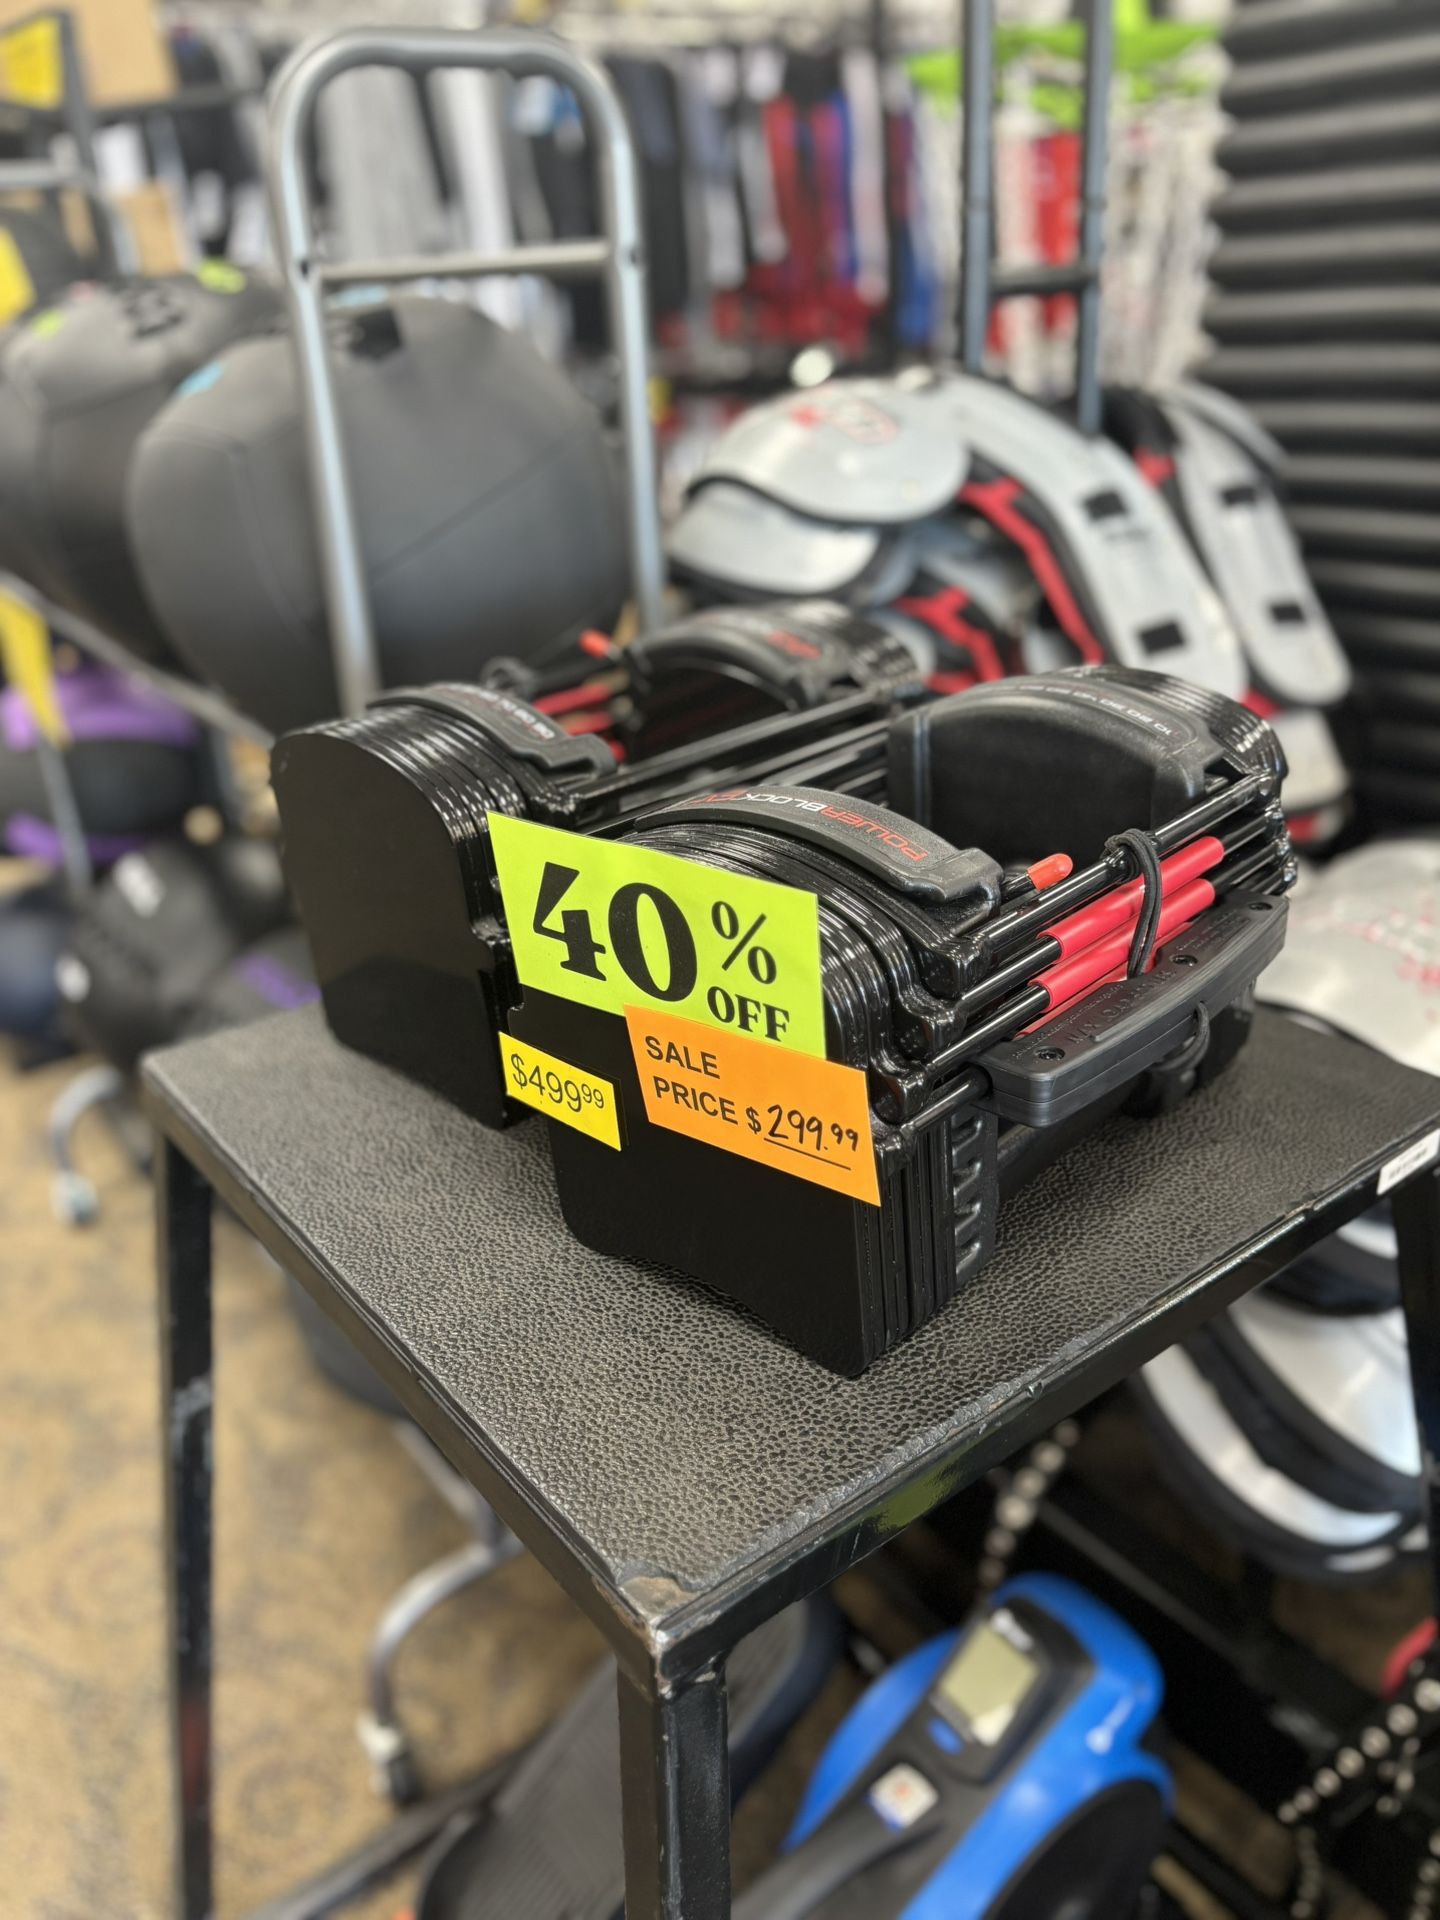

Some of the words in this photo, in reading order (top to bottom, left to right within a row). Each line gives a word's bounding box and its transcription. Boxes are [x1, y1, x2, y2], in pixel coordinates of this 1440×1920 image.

[746, 792, 928, 861] POWERBLOCK
[707, 985, 790, 1042] OFF
[645, 1034, 721, 1080] SALE
[653, 1075, 739, 1125] PRICE
